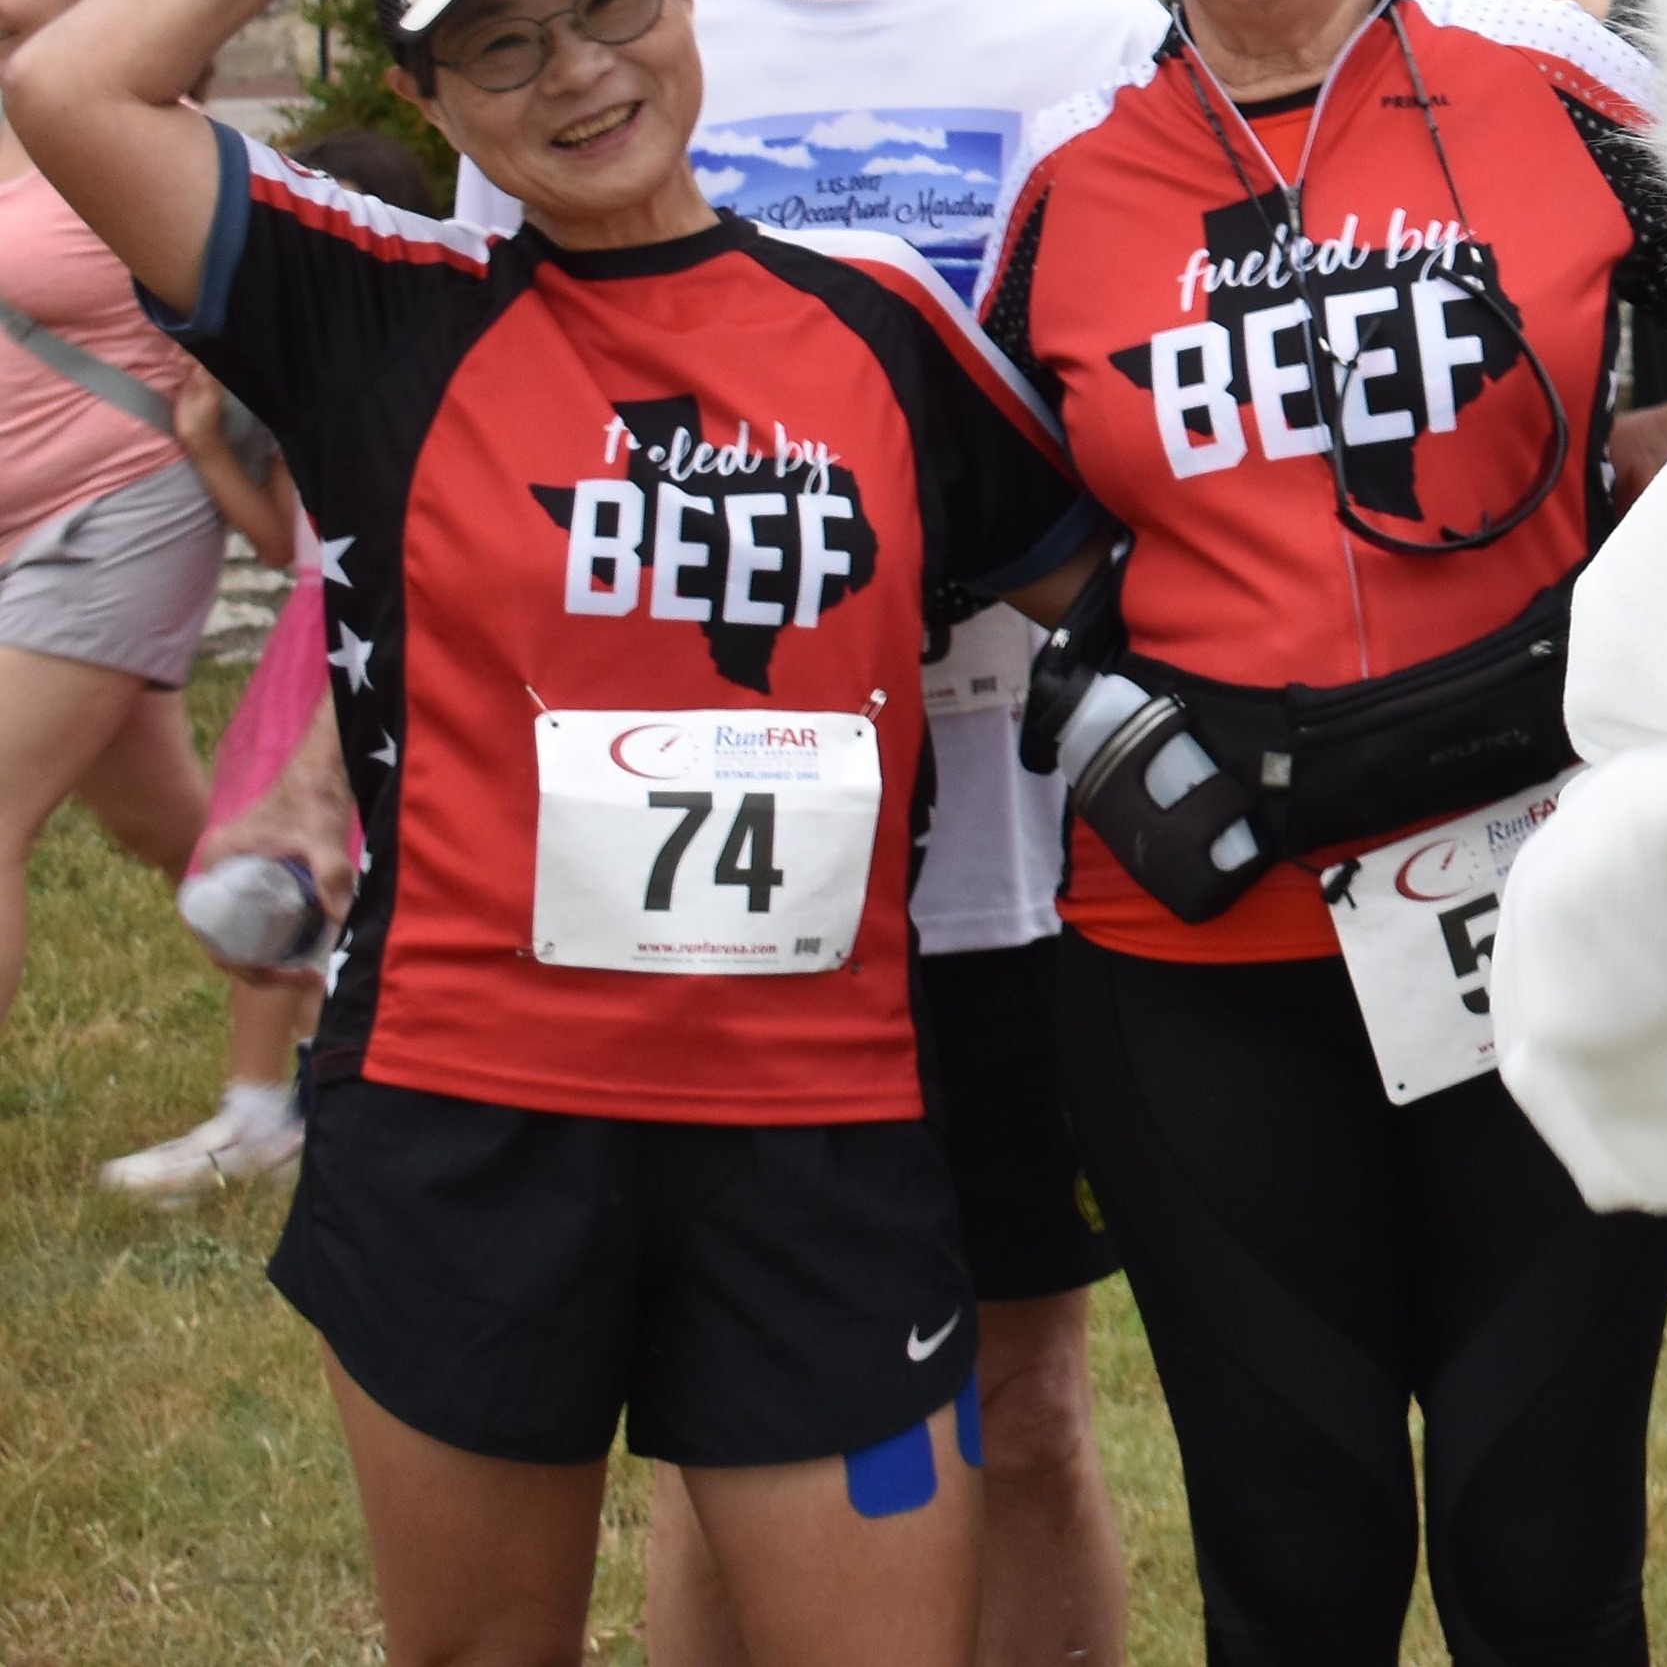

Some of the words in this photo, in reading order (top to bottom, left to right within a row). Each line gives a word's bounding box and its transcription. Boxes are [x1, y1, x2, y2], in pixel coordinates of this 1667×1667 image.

[1381, 94, 1452, 109] PRIAL
[894, 188, 994, 229] Marathon
[1384, 207, 1476, 284] by
[1150, 284, 1490, 480] BEEF
[773, 420, 842, 495] by
[564, 478, 854, 629] BEEF
[715, 726, 818, 748] RunFAR
[644, 791, 784, 913] 74
[1486, 792, 1560, 845] RunFA
